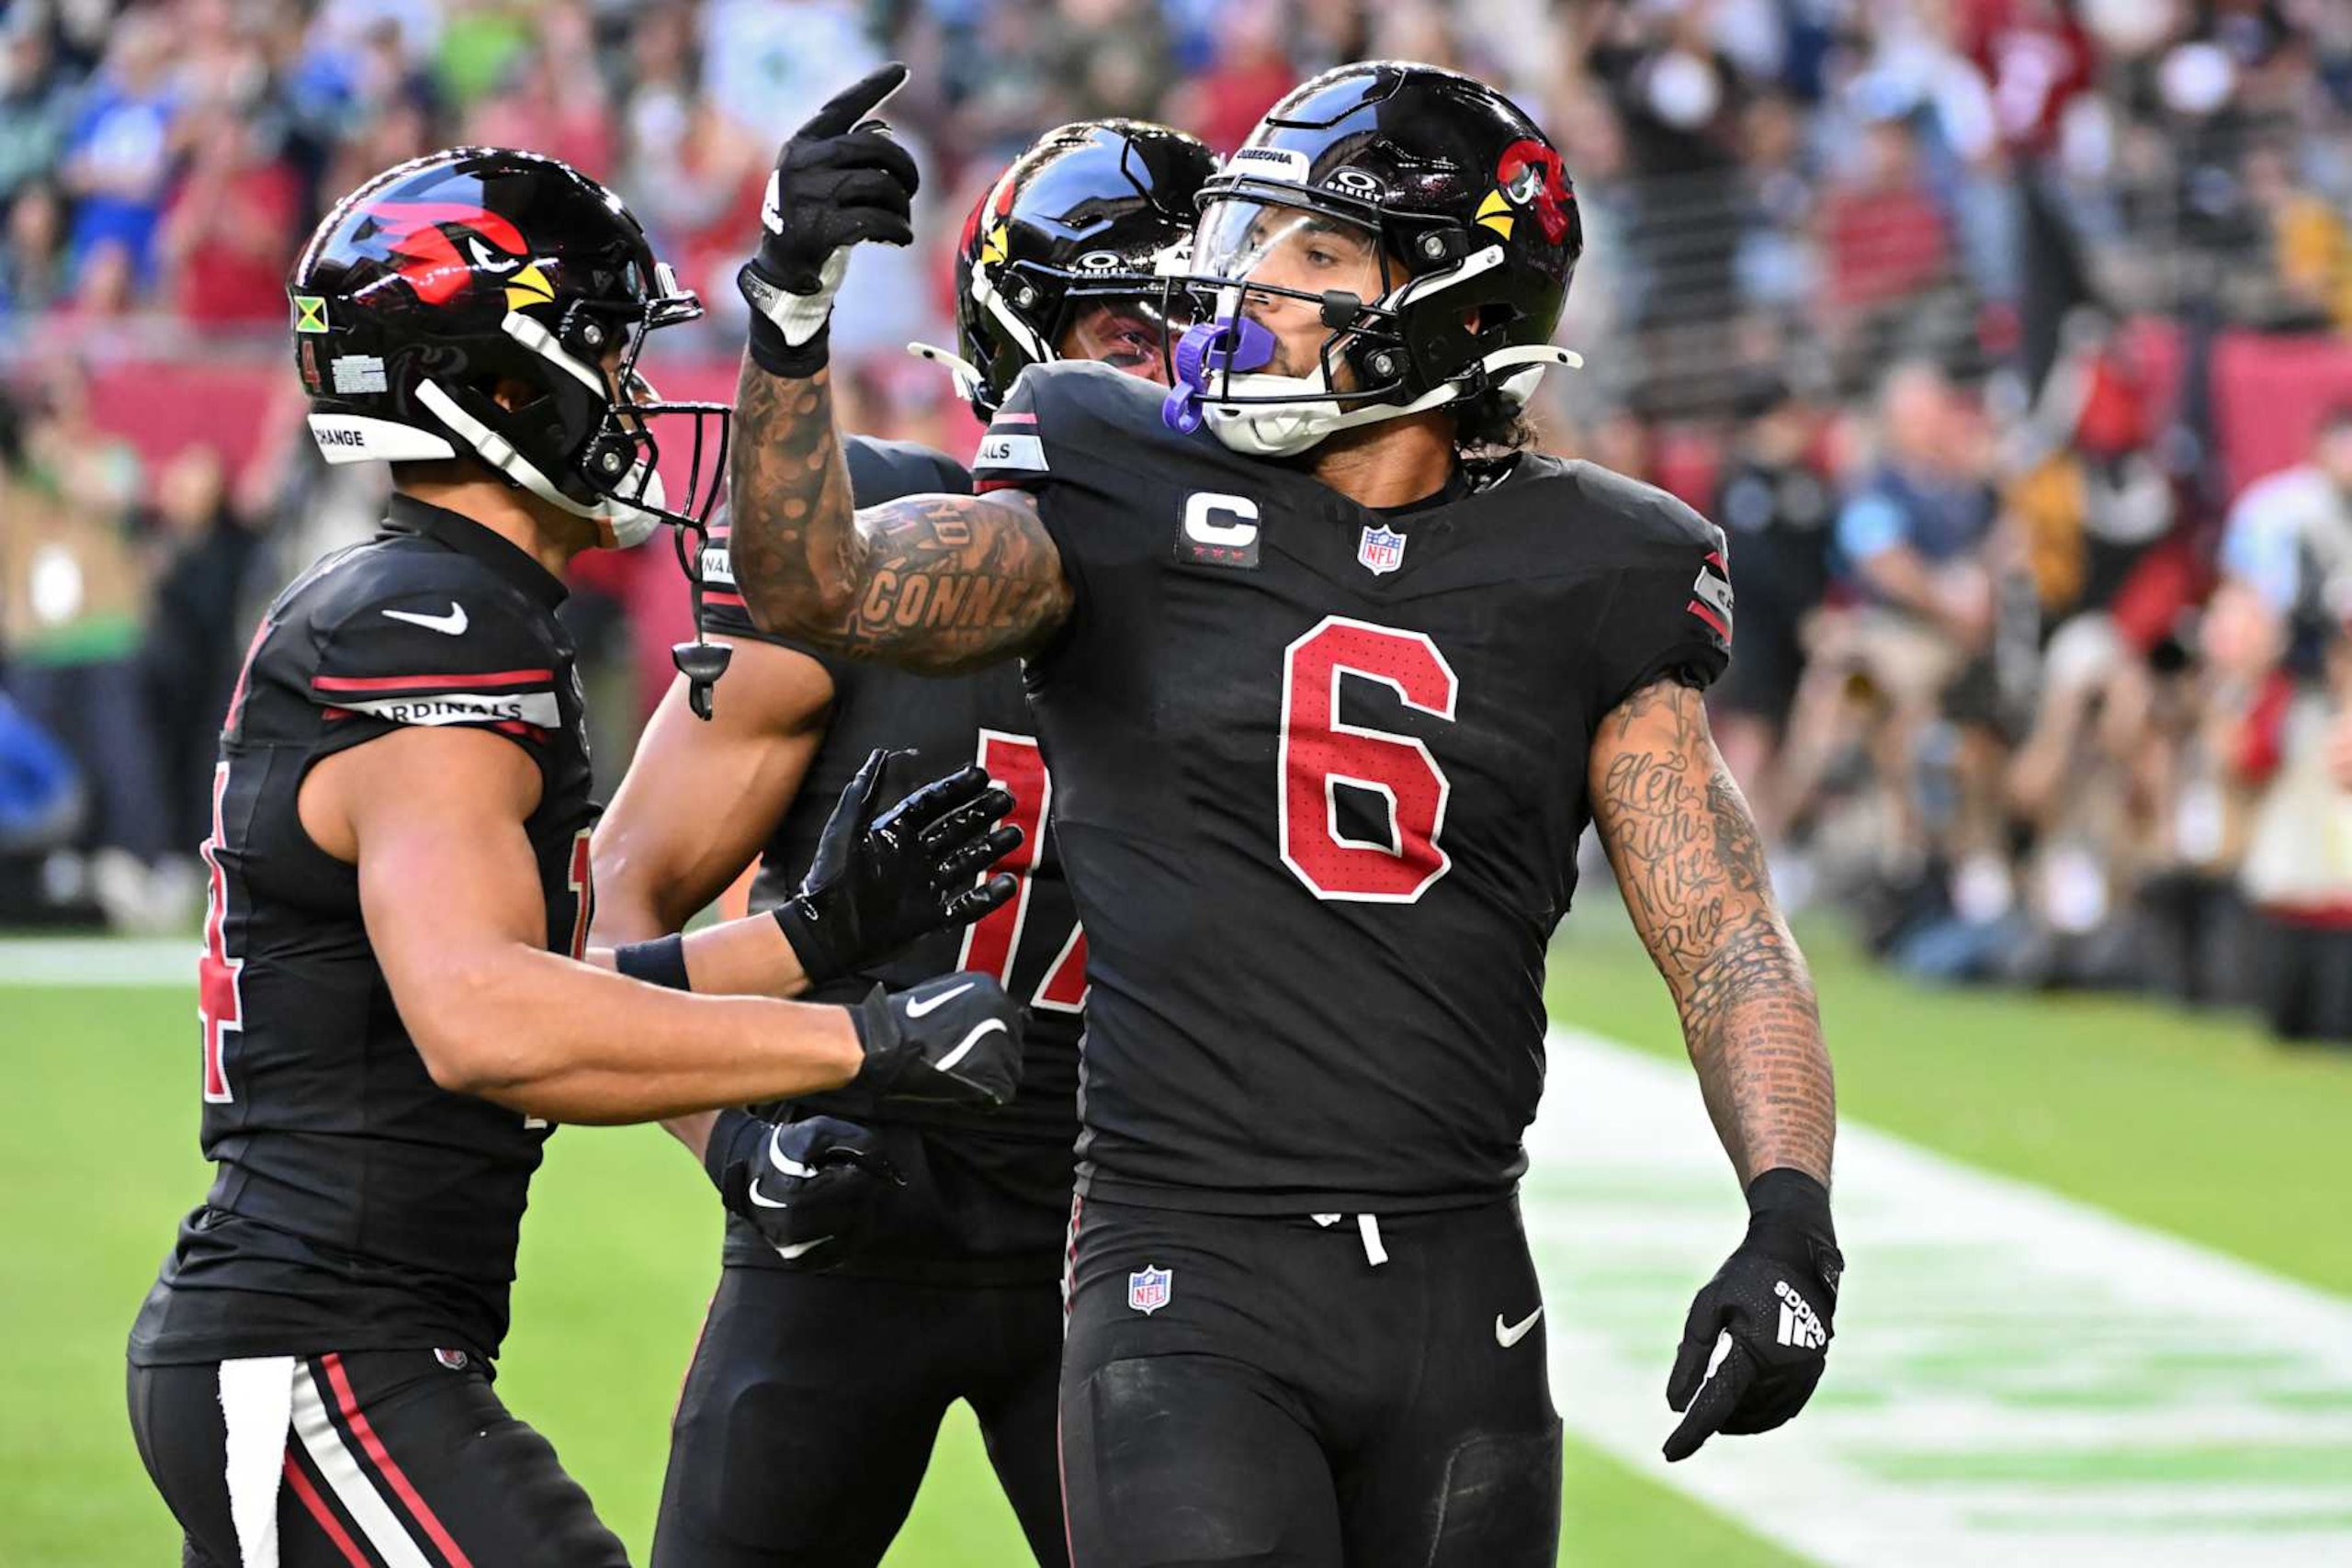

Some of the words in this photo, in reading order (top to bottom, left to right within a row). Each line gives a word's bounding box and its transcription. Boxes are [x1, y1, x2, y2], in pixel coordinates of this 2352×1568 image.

[1237, 149, 1292, 165] ARIZONA
[1326, 180, 1384, 202] OAKLEY
[1185, 491, 1261, 548] C
[1366, 543, 1395, 566] NFL
[371, 702, 523, 722] ARDINALS
[1277, 614, 1459, 905] 6
[1136, 1285, 1165, 1304] NFL
[1773, 1280, 1827, 1347] adidas
